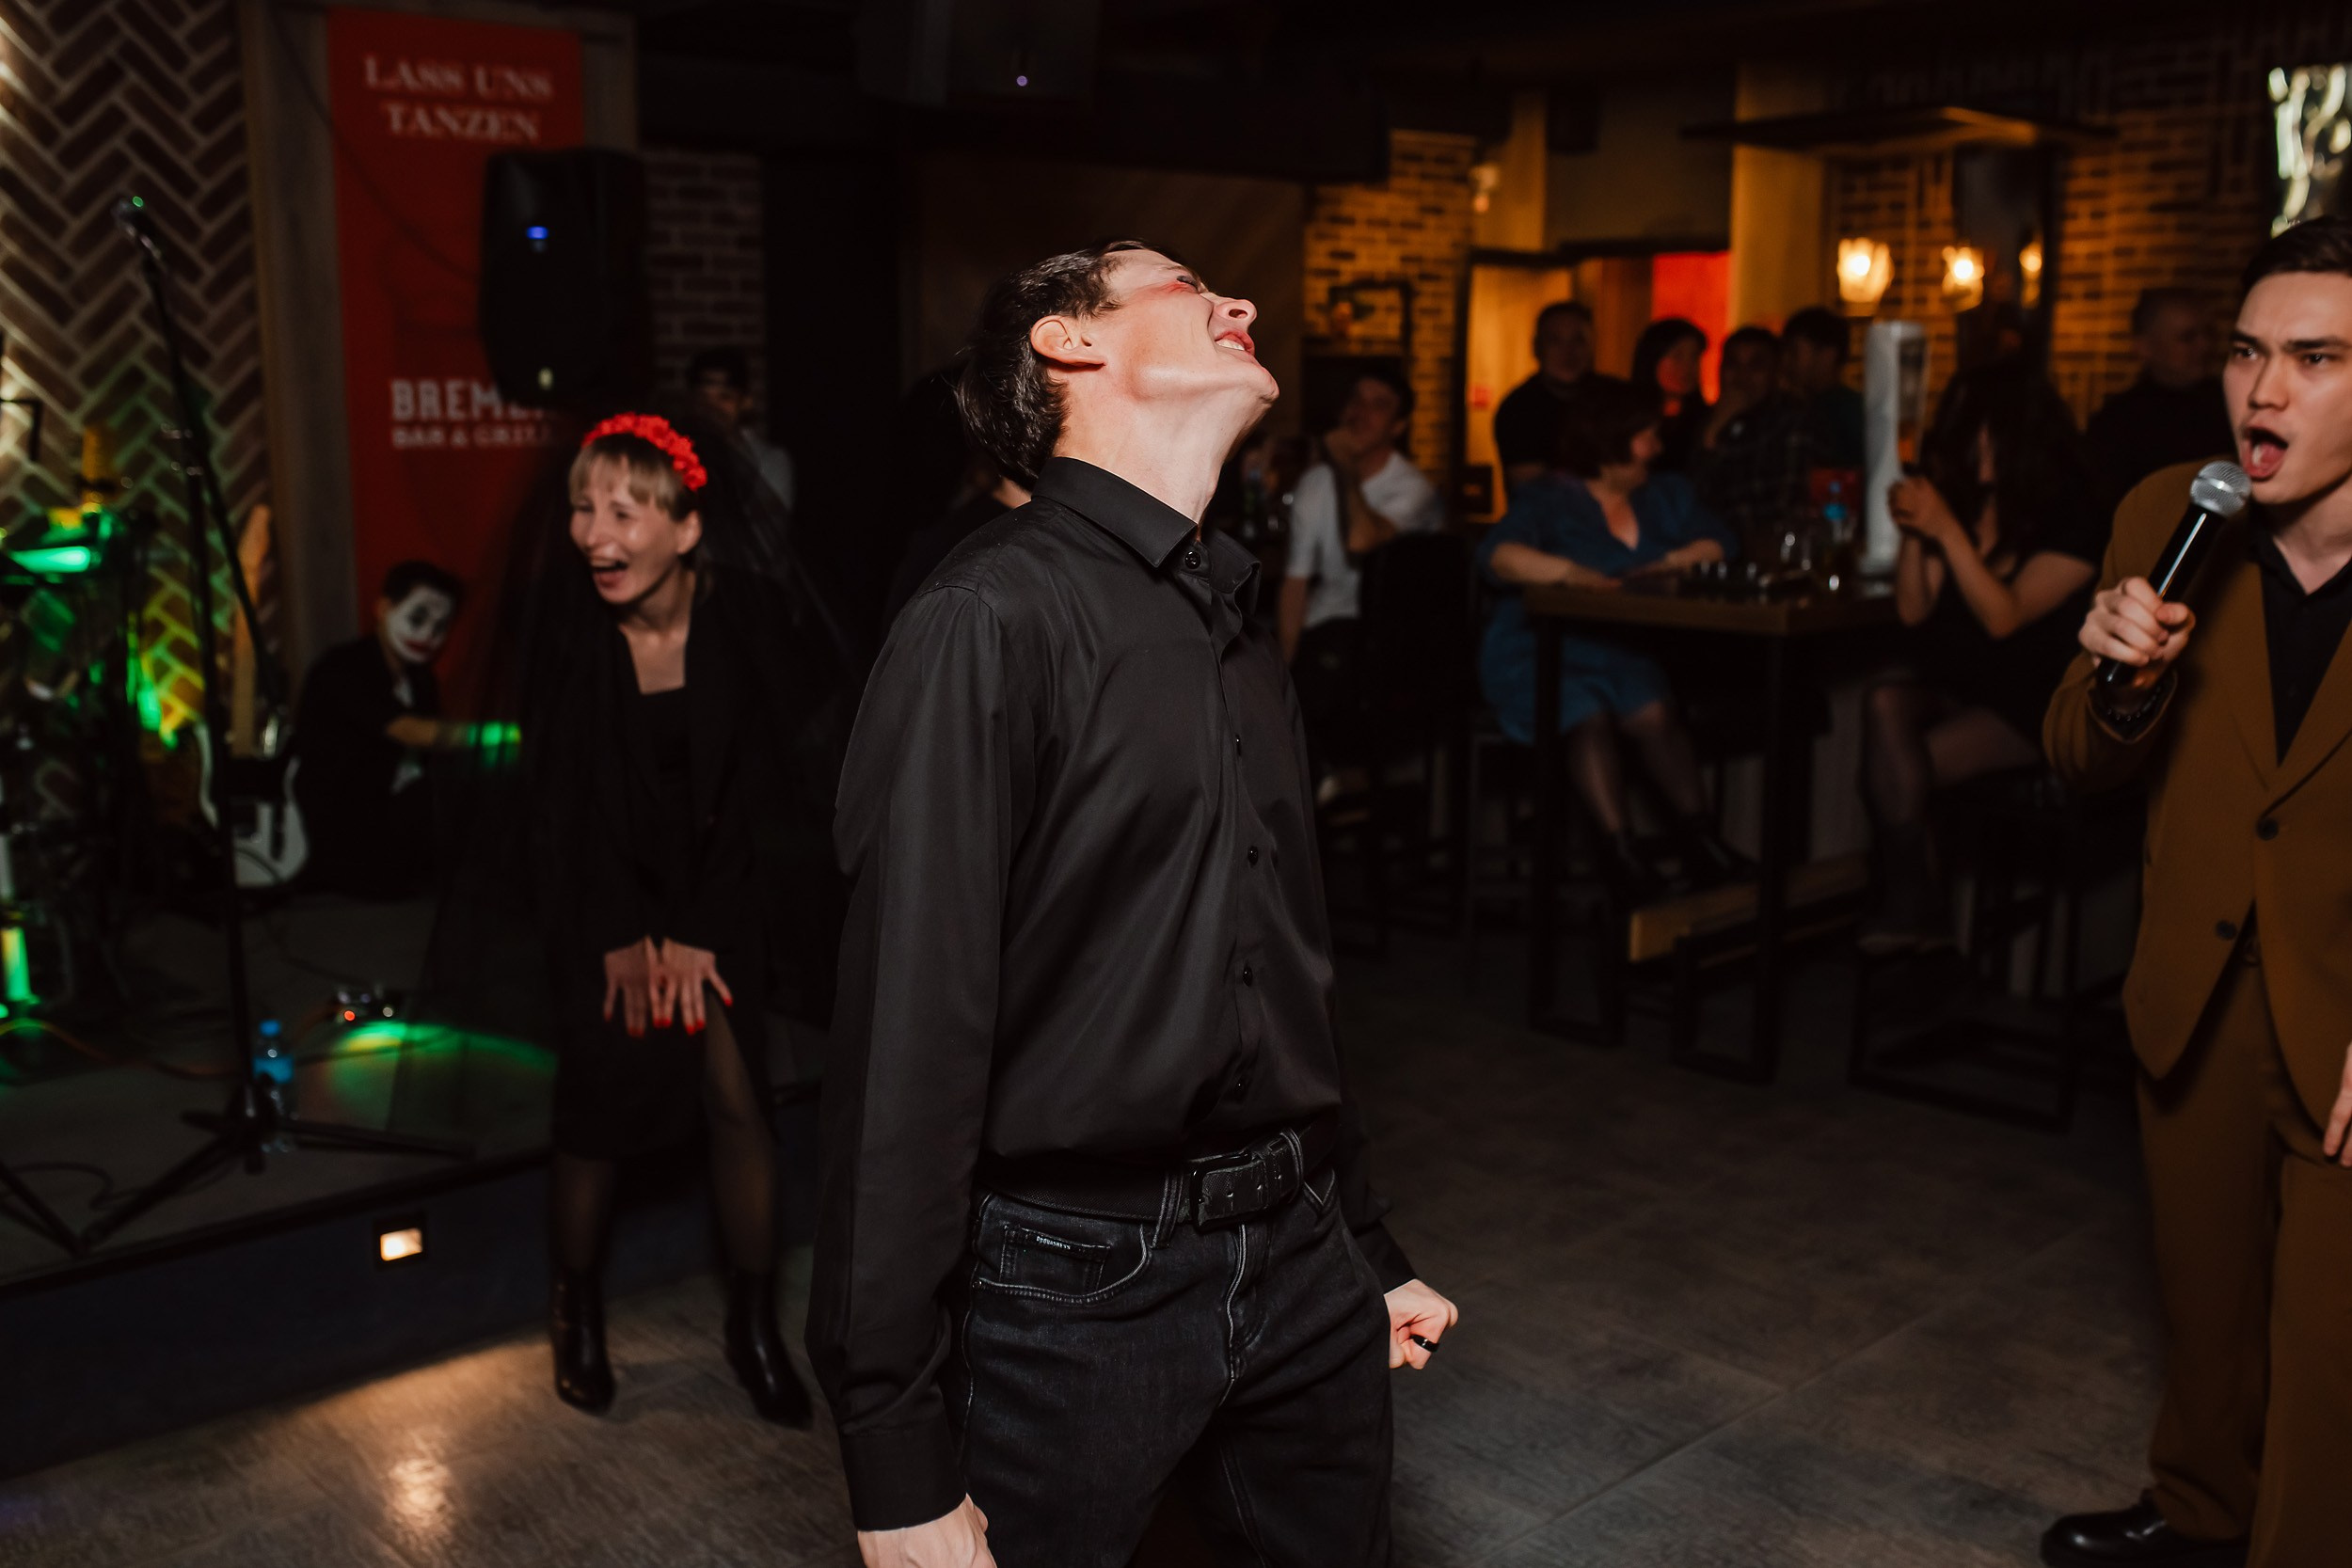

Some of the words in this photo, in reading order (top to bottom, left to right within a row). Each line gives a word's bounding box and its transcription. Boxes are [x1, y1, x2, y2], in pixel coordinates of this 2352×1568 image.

[364, 54, 466, 93] LASS
[473, 64, 553, 102] UNS
[382, 101, 540, 143] TANZEN
[389, 378, 546, 420] BREM
[391, 425, 446, 449] BAR
[450, 426, 469, 449] &
